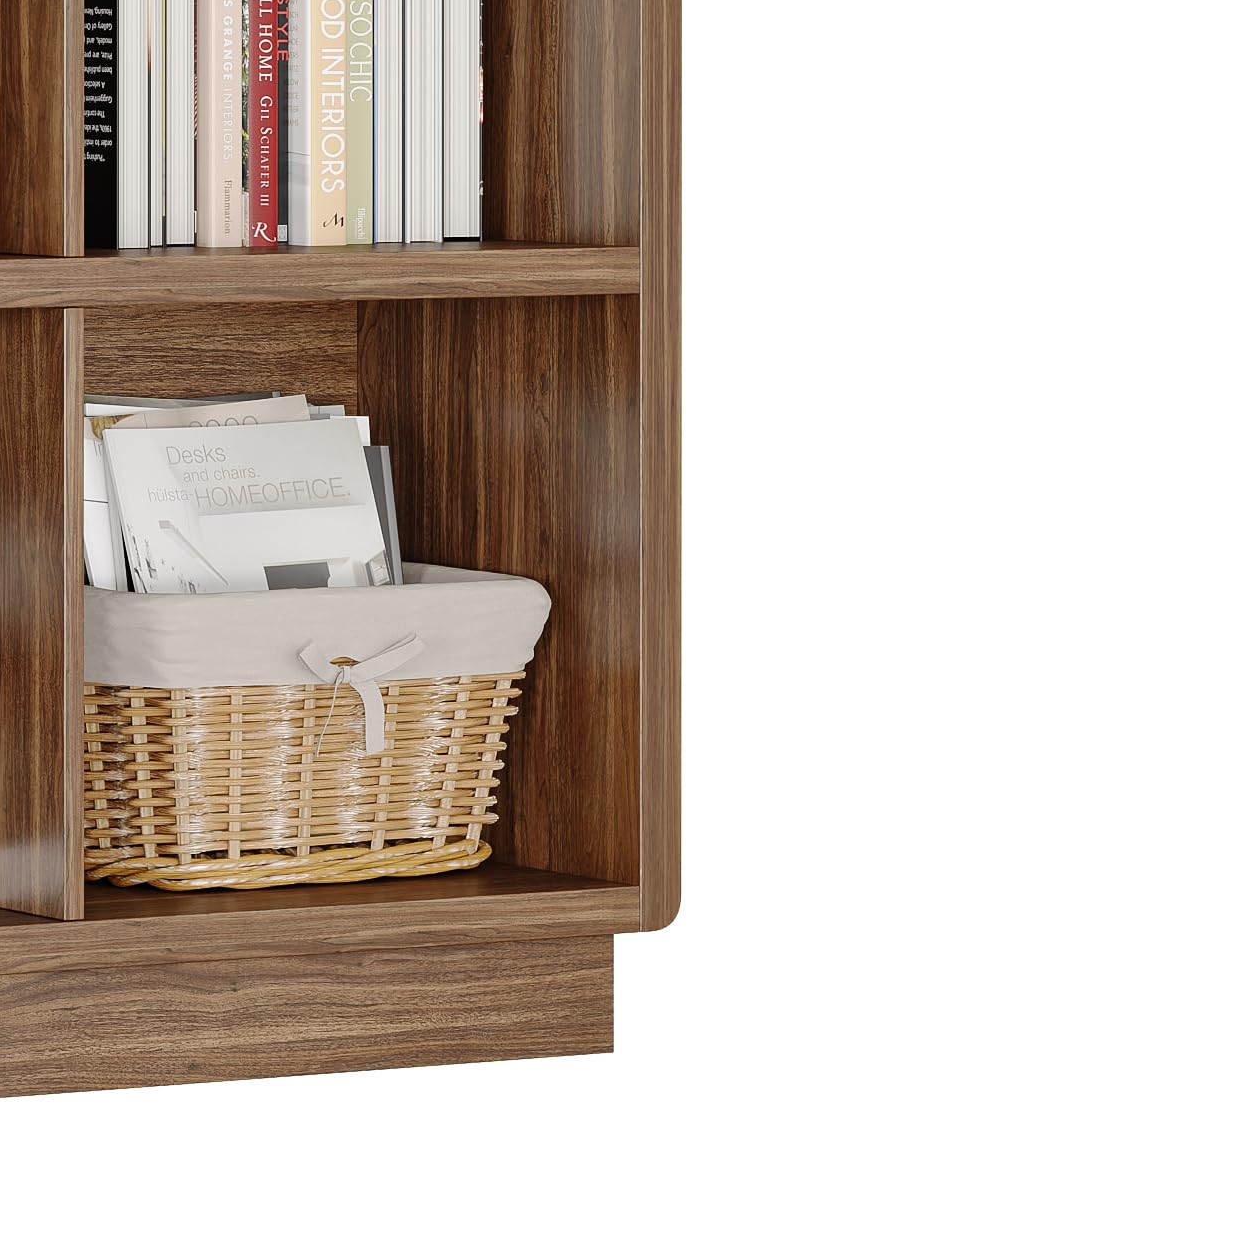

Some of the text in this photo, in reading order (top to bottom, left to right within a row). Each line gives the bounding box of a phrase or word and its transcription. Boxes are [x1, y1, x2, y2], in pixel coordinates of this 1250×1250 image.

[223, 17, 234, 81] GRANGE
[258, 23, 273, 83] HOME
[350, 1, 372, 102] SO CHIC
[223, 87, 234, 160] INTERIORS
[320, 48, 345, 193] INTERIORS
[224, 180, 233, 234] Flammarion
[260, 194, 269, 207] III
[165, 443, 226, 466] Desks
[183, 466, 260, 483] and chairs.
